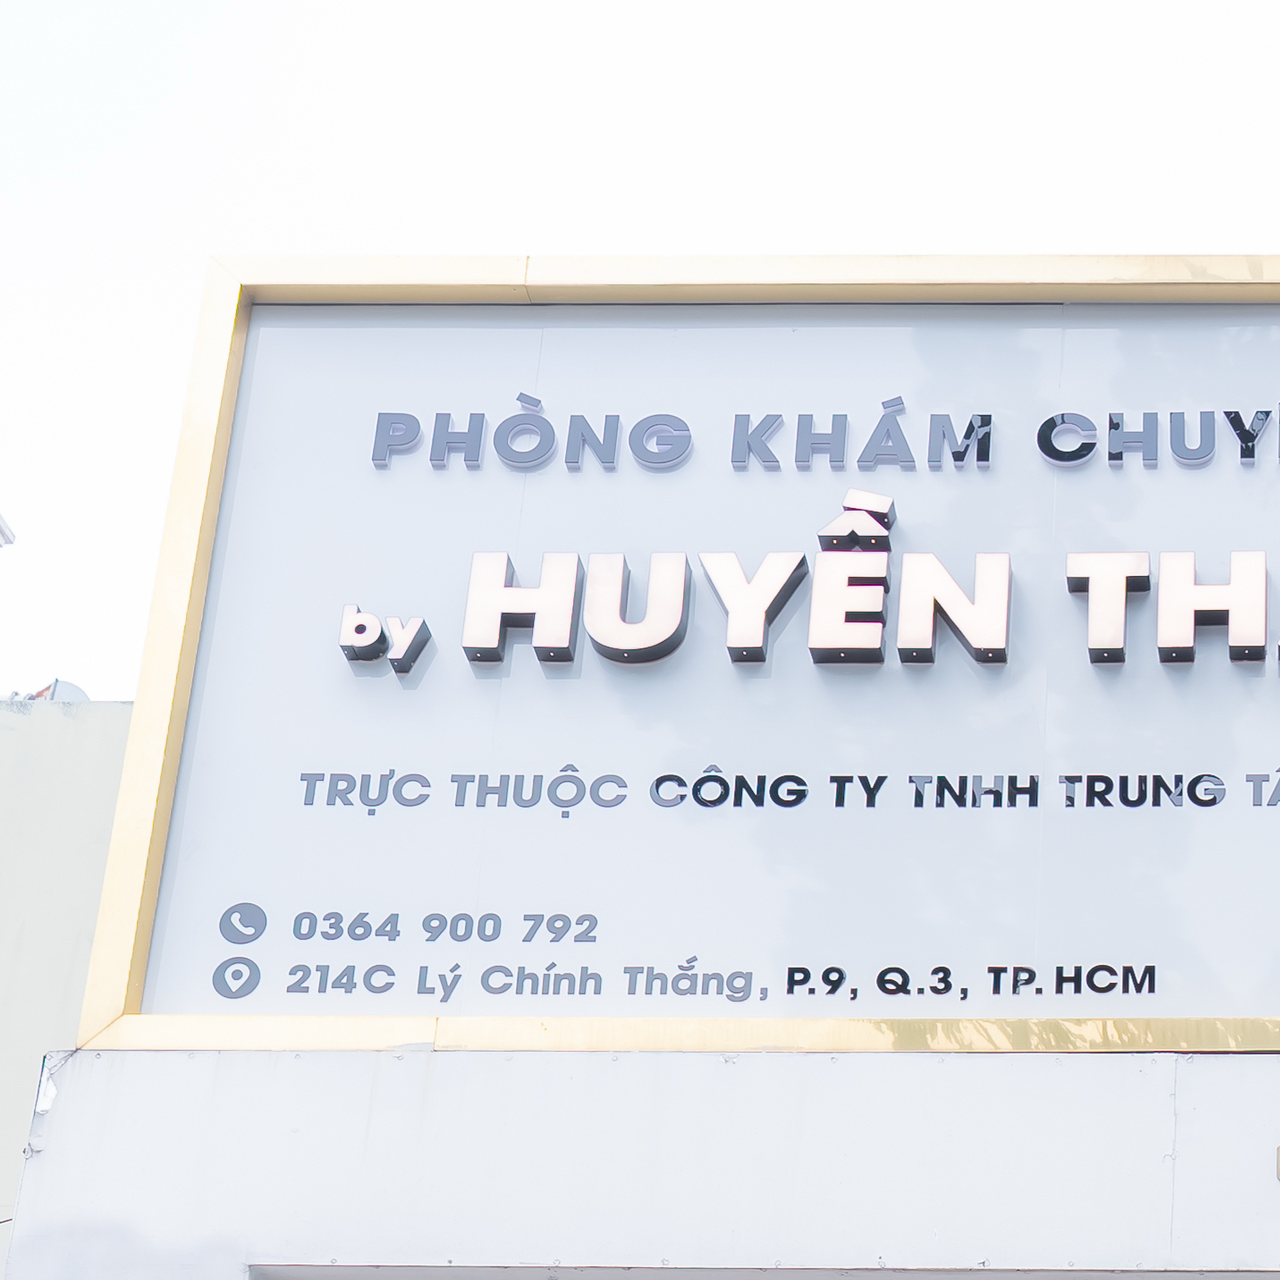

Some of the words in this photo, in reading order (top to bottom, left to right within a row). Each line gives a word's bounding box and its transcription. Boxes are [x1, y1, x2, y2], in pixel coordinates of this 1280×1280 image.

[372, 391, 694, 468] PHÒNG
[730, 394, 993, 469] KHÁM
[339, 604, 432, 674] by
[461, 487, 1012, 664] HUYỀN
[300, 765, 431, 817] TRỰC
[449, 763, 627, 819] THUỘC
[649, 763, 808, 809] CÔNG
[830, 774, 887, 808] TY
[908, 774, 1039, 808] TNHH
[1059, 773, 1226, 808] TRUNG
[292, 911, 401, 943] 0364
[421, 911, 503, 943] 900
[520, 911, 598, 943] 792
[286, 964, 396, 995] 214C
[415, 963, 462, 1002] Lý
[480, 962, 603, 996] Chính
[622, 954, 770, 1003] Thắng,
[785, 965, 860, 1001] P.9,
[875, 965, 969, 1001] Q.3,
